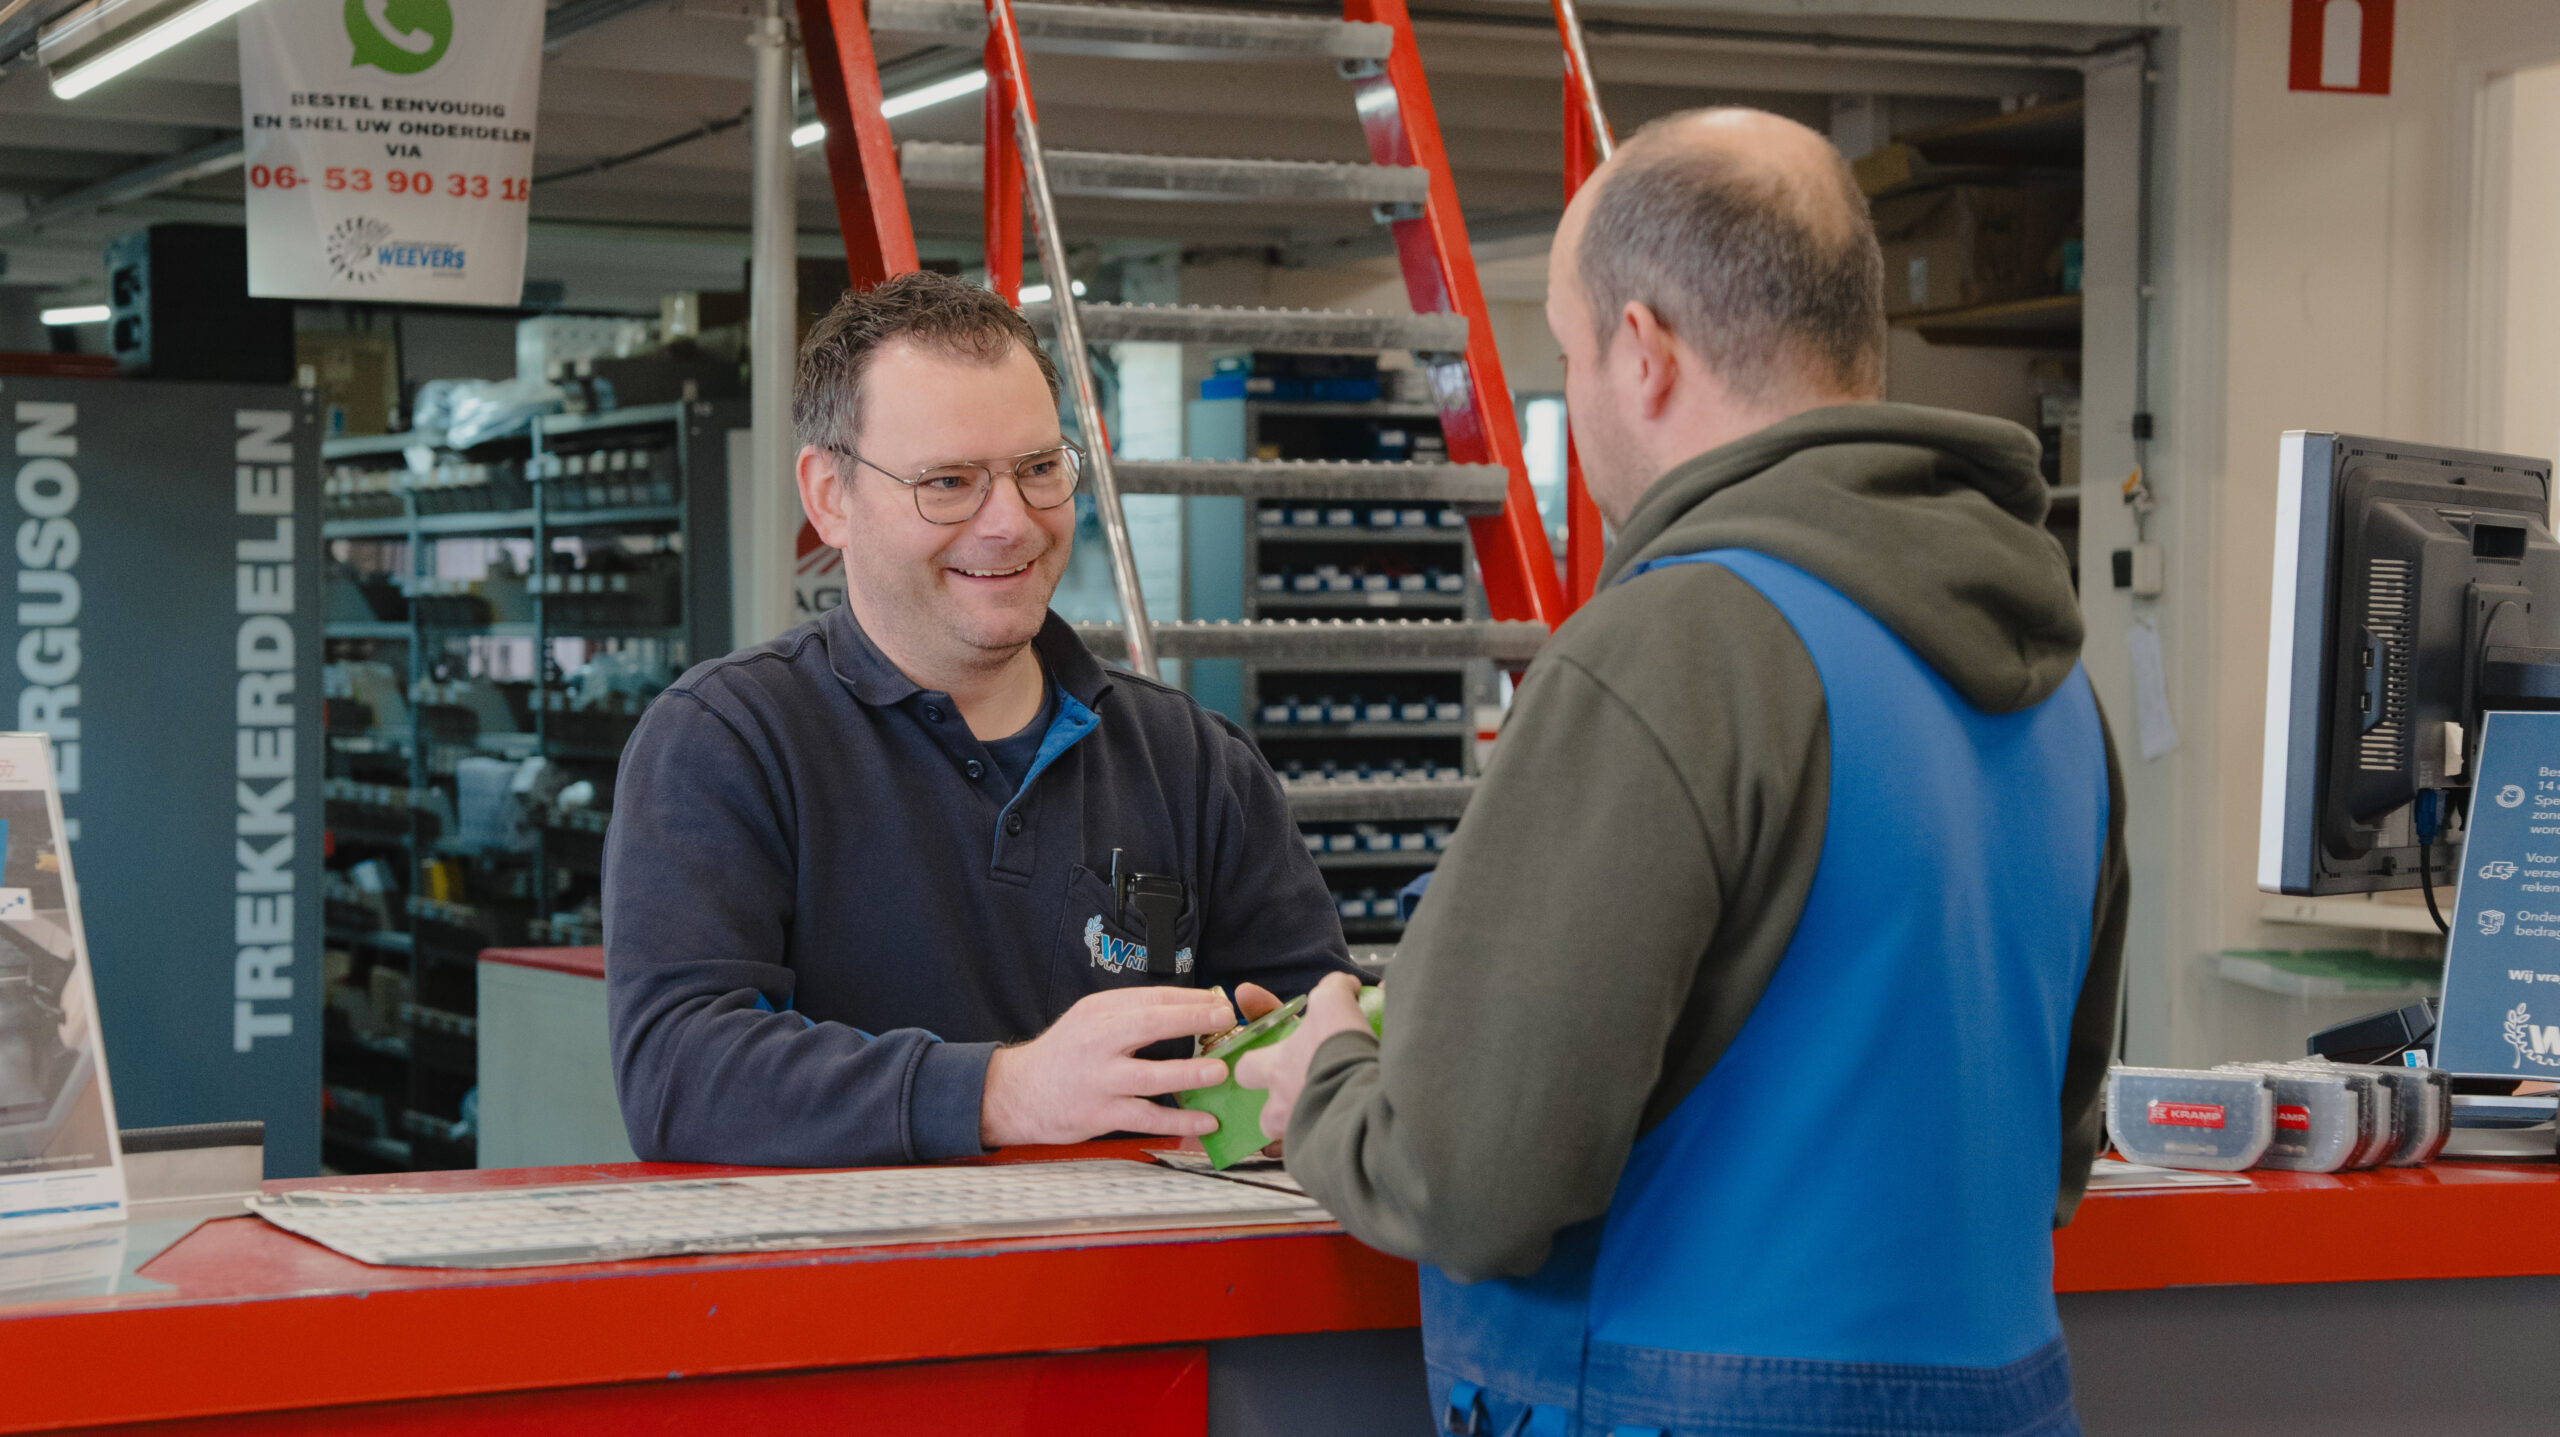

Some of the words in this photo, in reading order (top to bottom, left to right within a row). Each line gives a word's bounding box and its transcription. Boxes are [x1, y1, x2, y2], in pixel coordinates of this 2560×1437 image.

[290, 92, 374, 111] BESTEL
[382, 96, 506, 119] EENVOUDIG
[252, 113, 282, 130] EN
[289, 115, 348, 133] SNEL
[356, 118, 391, 135] UW
[399, 119, 531, 143] ONDERDELEN
[386, 142, 422, 159] VIA
[250, 164, 310, 190] 06-
[324, 166, 373, 192] 53
[386, 169, 433, 196] 90
[447, 173, 490, 199] 33
[378, 247, 466, 269] WEEVERS
[15, 402, 82, 841] ERGUSON
[234, 409, 296, 1052] TREKKERDELEN
[2538, 780, 2555, 791] 14
[2525, 851, 2559, 864] Voor
[2507, 969, 2534, 984] Wij
[2170, 1109, 2222, 1121] KRAMP
[2279, 1112, 2308, 1122] AMP
